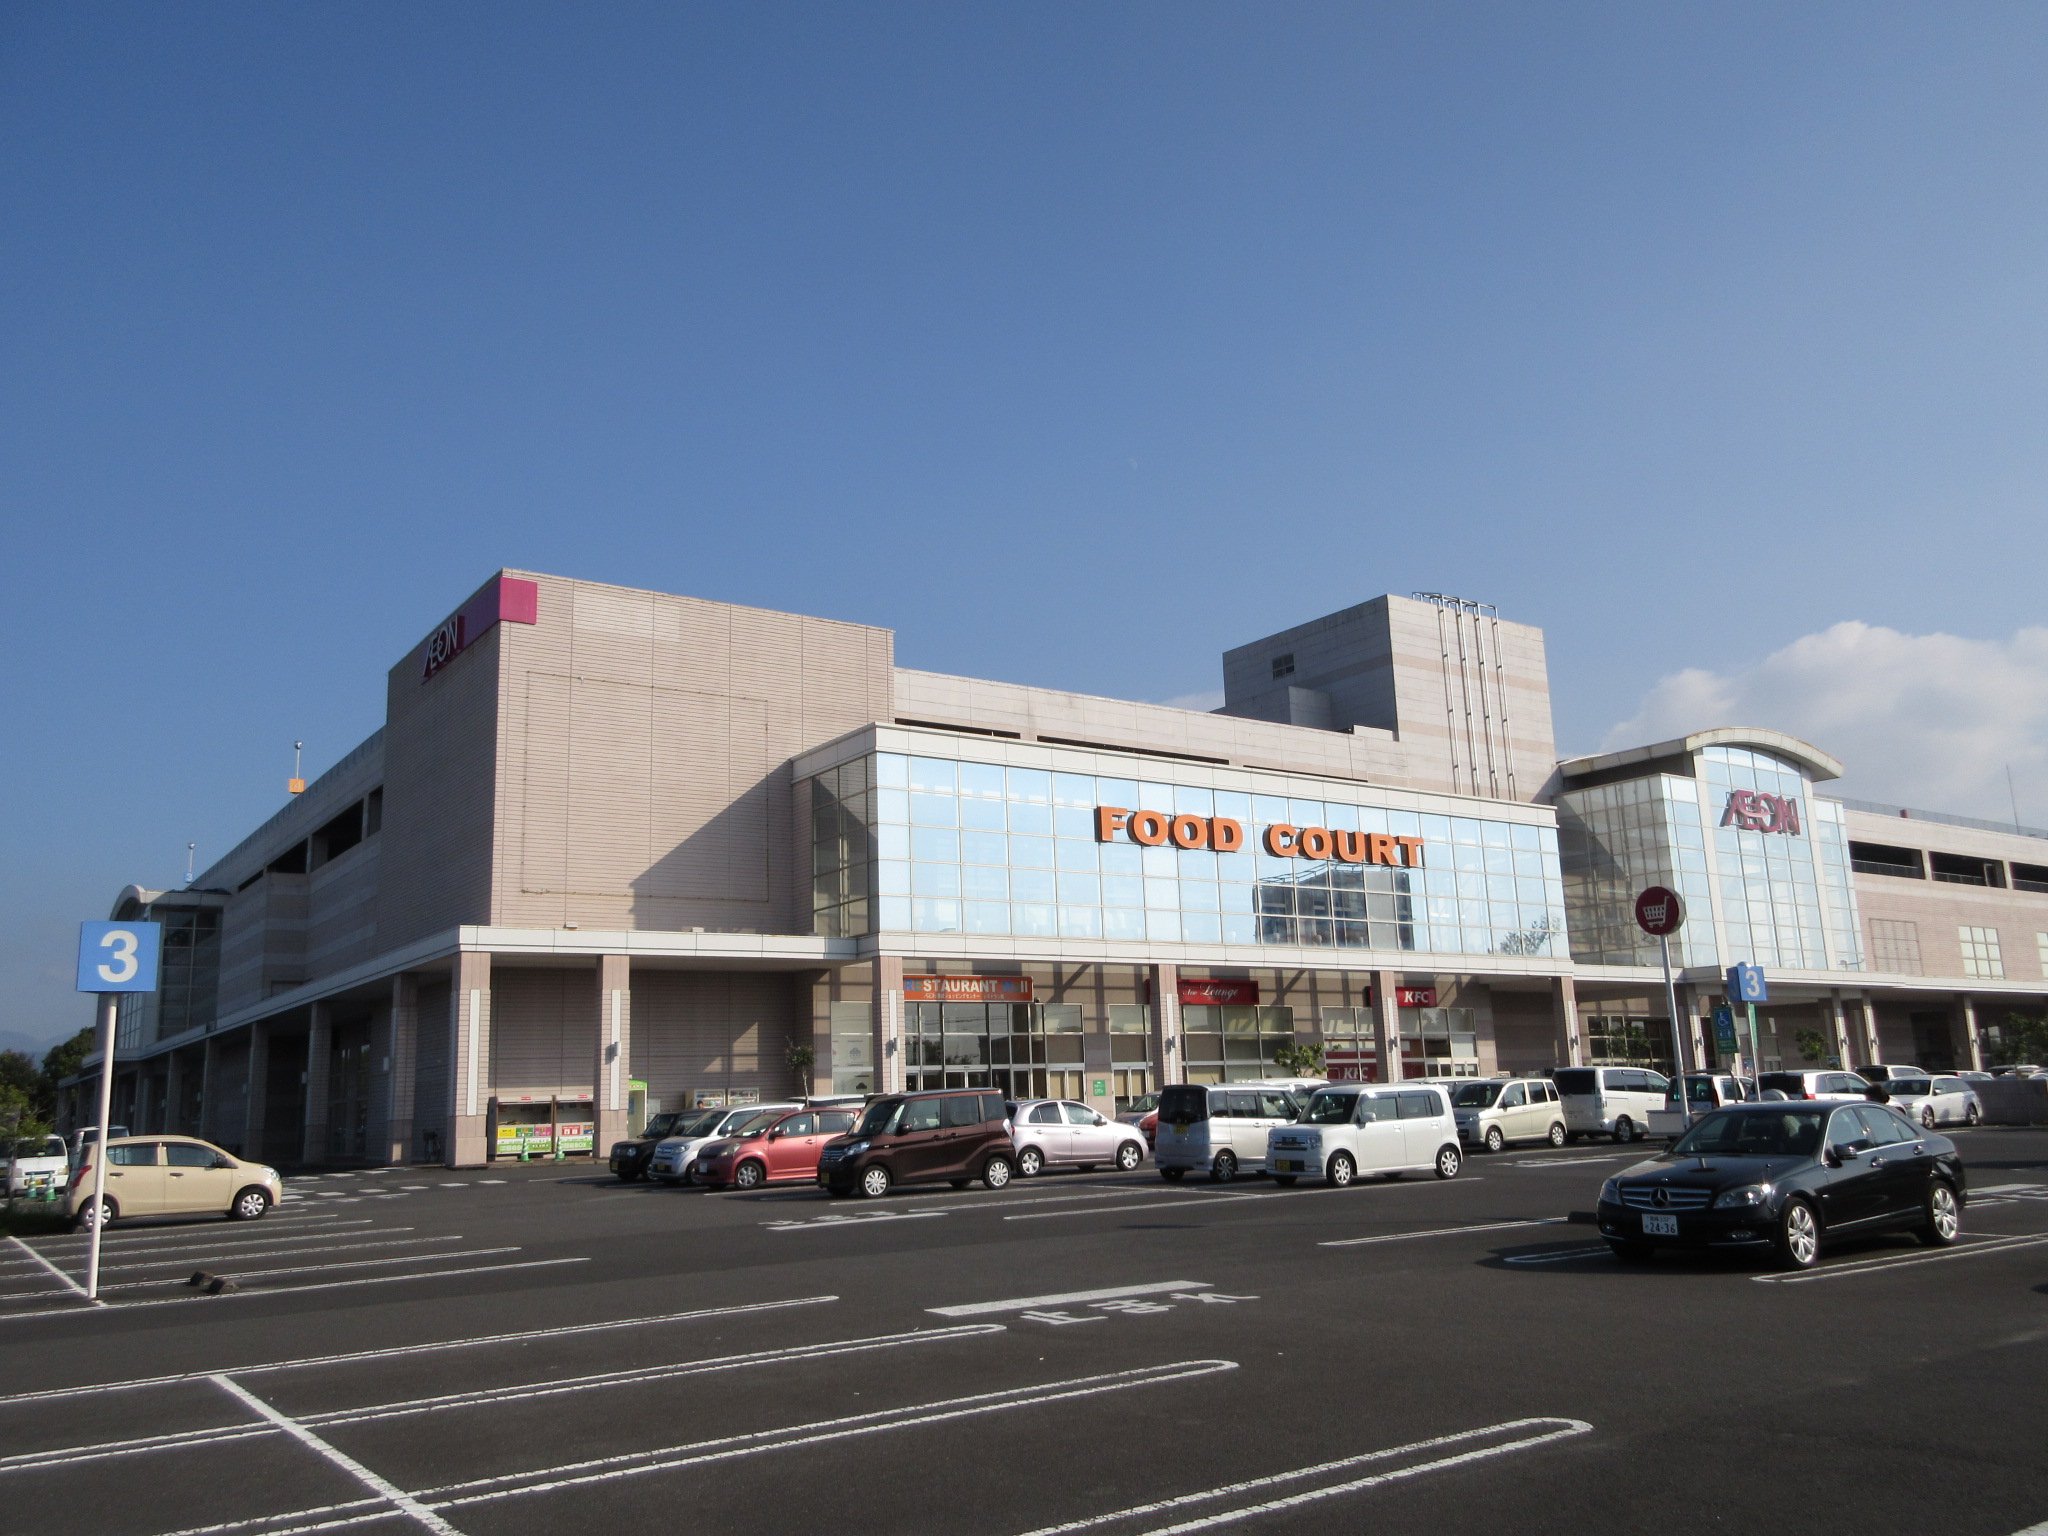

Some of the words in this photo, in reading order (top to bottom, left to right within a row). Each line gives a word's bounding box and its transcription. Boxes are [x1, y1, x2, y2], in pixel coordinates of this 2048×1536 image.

[1097, 806, 1243, 852] FOOD
[1263, 824, 1424, 868] COURT
[98, 929, 139, 983] 3
[904, 979, 997, 992] RESTAURANT
[1200, 983, 1239, 1001] Lounge
[1404, 991, 1429, 1003] KFC
[1745, 970, 1760, 997] 3
[1020, 1293, 1261, 1325] 止まれ
